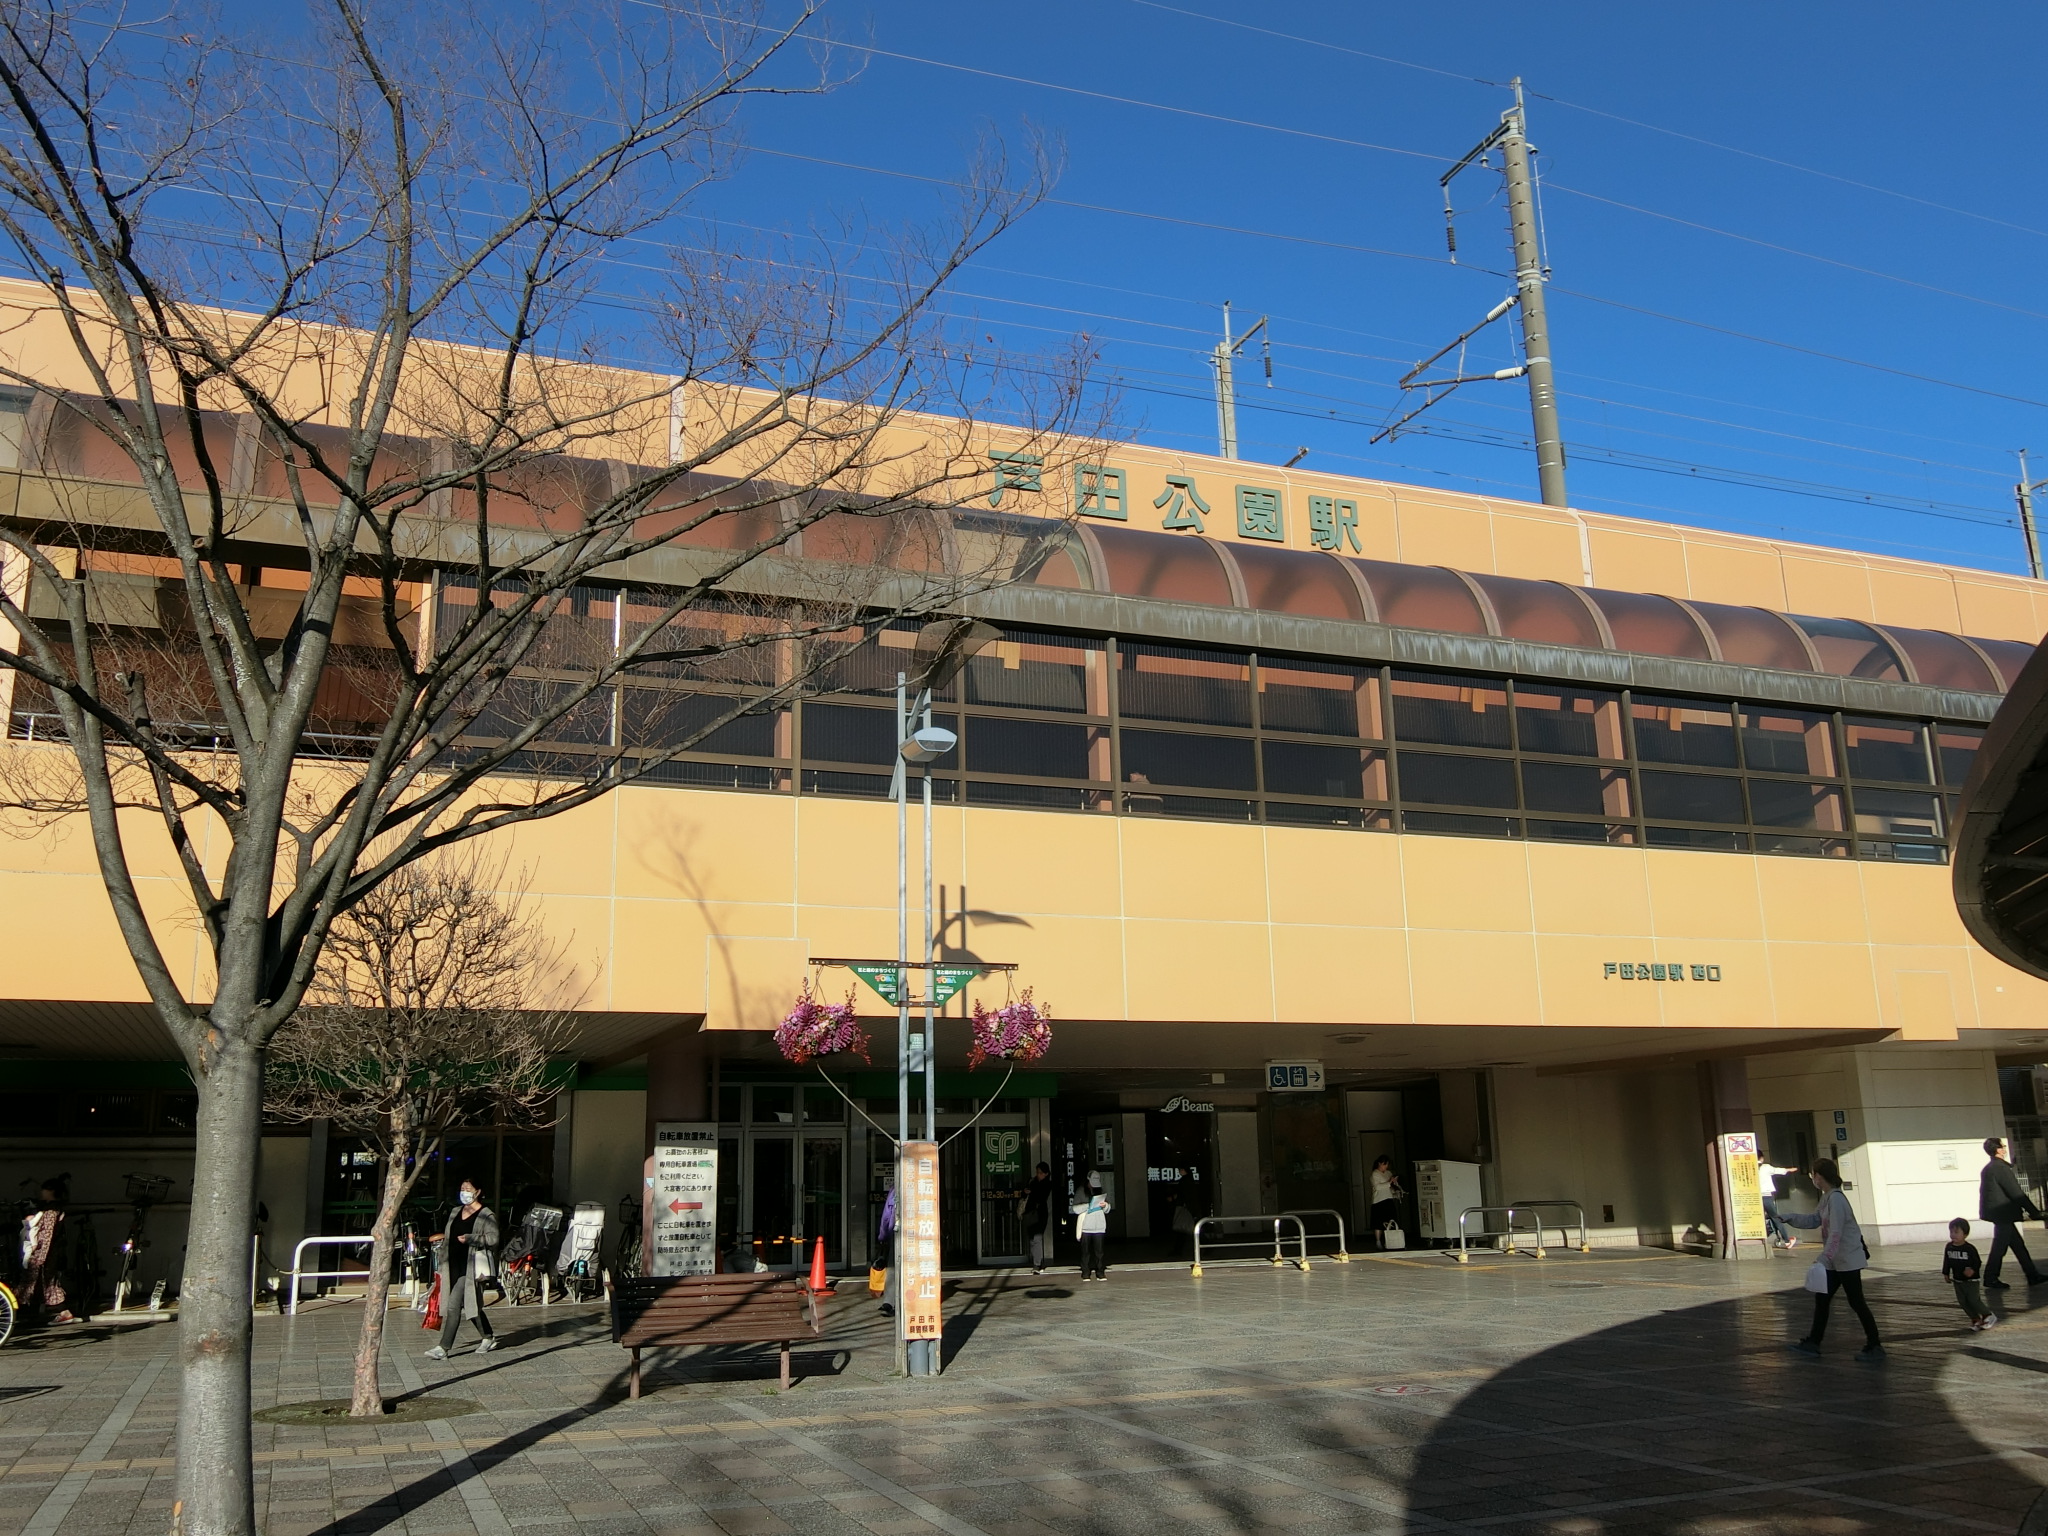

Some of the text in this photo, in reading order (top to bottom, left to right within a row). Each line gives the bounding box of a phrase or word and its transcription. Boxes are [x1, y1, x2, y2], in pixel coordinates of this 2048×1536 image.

[988, 450, 1362, 553] 戸田公園駅
[1181, 1098, 1214, 1113] Beans
[659, 1131, 714, 1141] 自転車放置禁止
[985, 1161, 1020, 1173] サミット
[918, 1158, 937, 1299] 自転車放置禁止
[1947, 1250, 1969, 1260] SMILE
[909, 1315, 935, 1324] 戸田市
